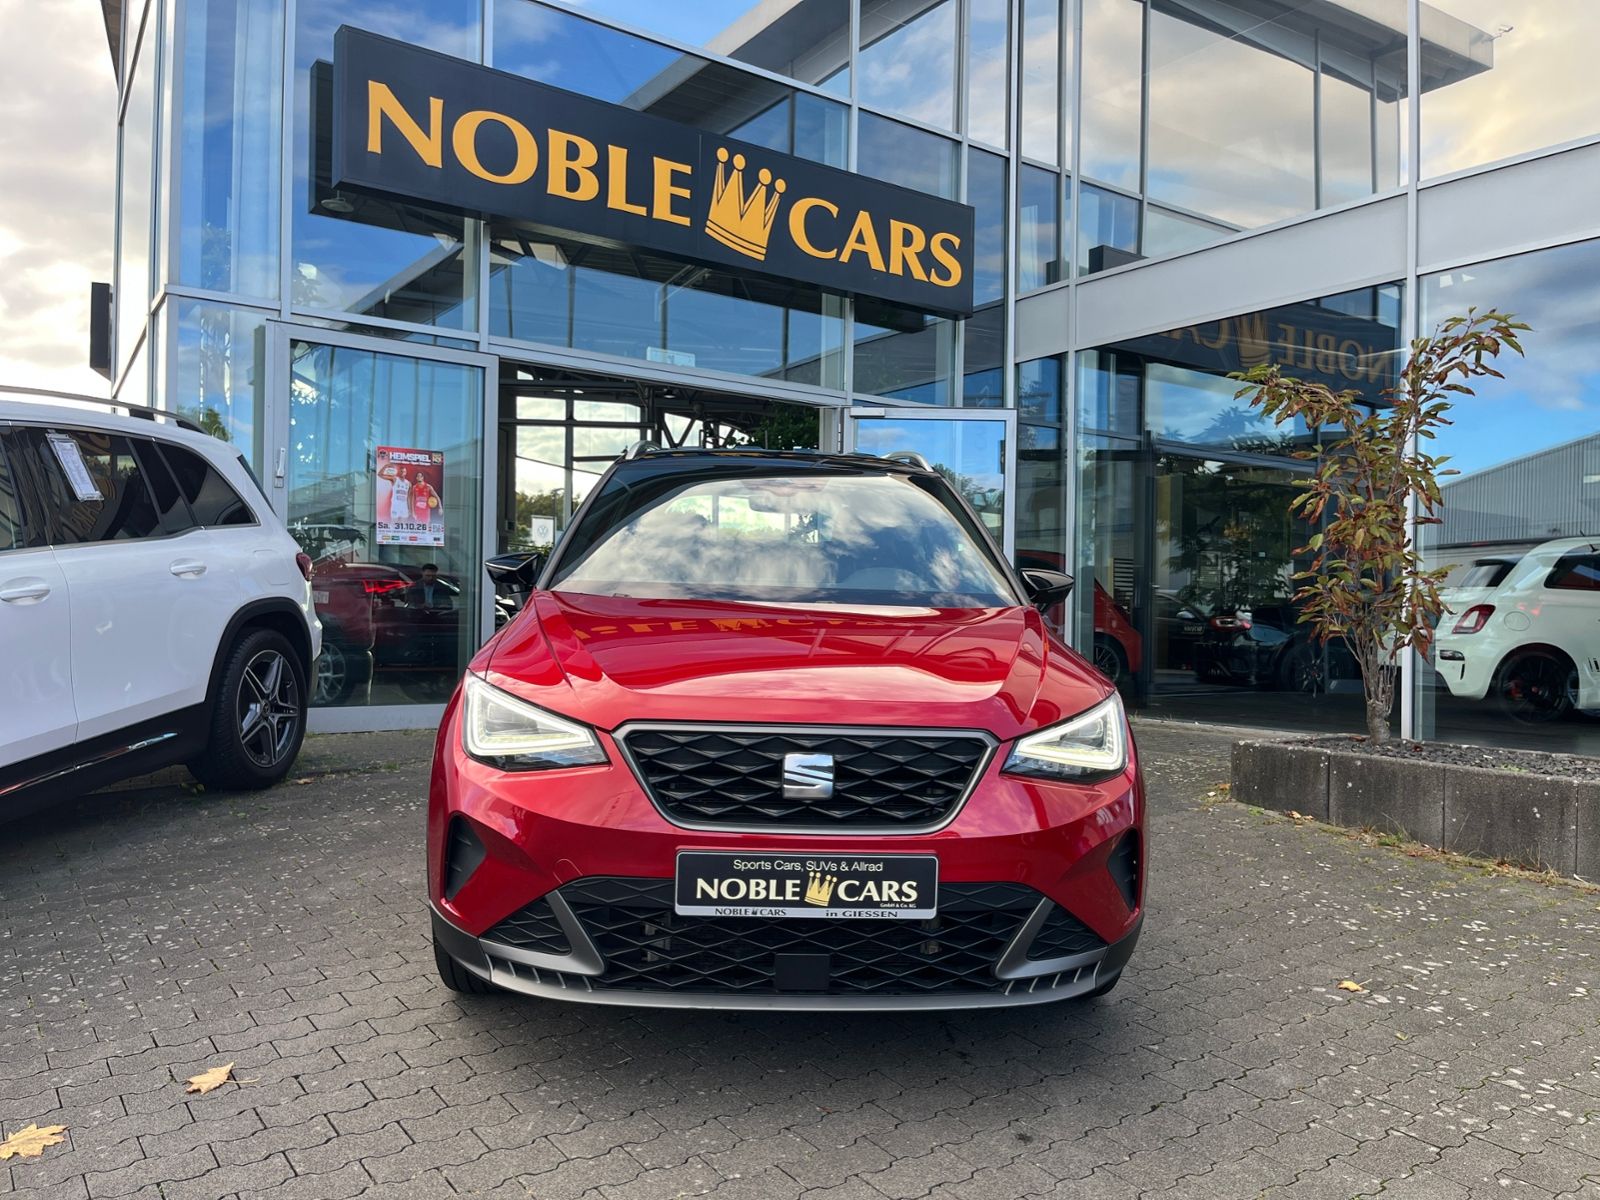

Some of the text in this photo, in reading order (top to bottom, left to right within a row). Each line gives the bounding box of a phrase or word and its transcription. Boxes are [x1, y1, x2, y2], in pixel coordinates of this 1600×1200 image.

[367, 80, 962, 287] NOBLE CARS
[733, 860, 883, 872] Sports Cars, SUVs & Allrad
[696, 878, 918, 902] NOBLE CARS
[715, 908, 749, 916] NOBLE
[842, 910, 898, 918] GIESSEN
